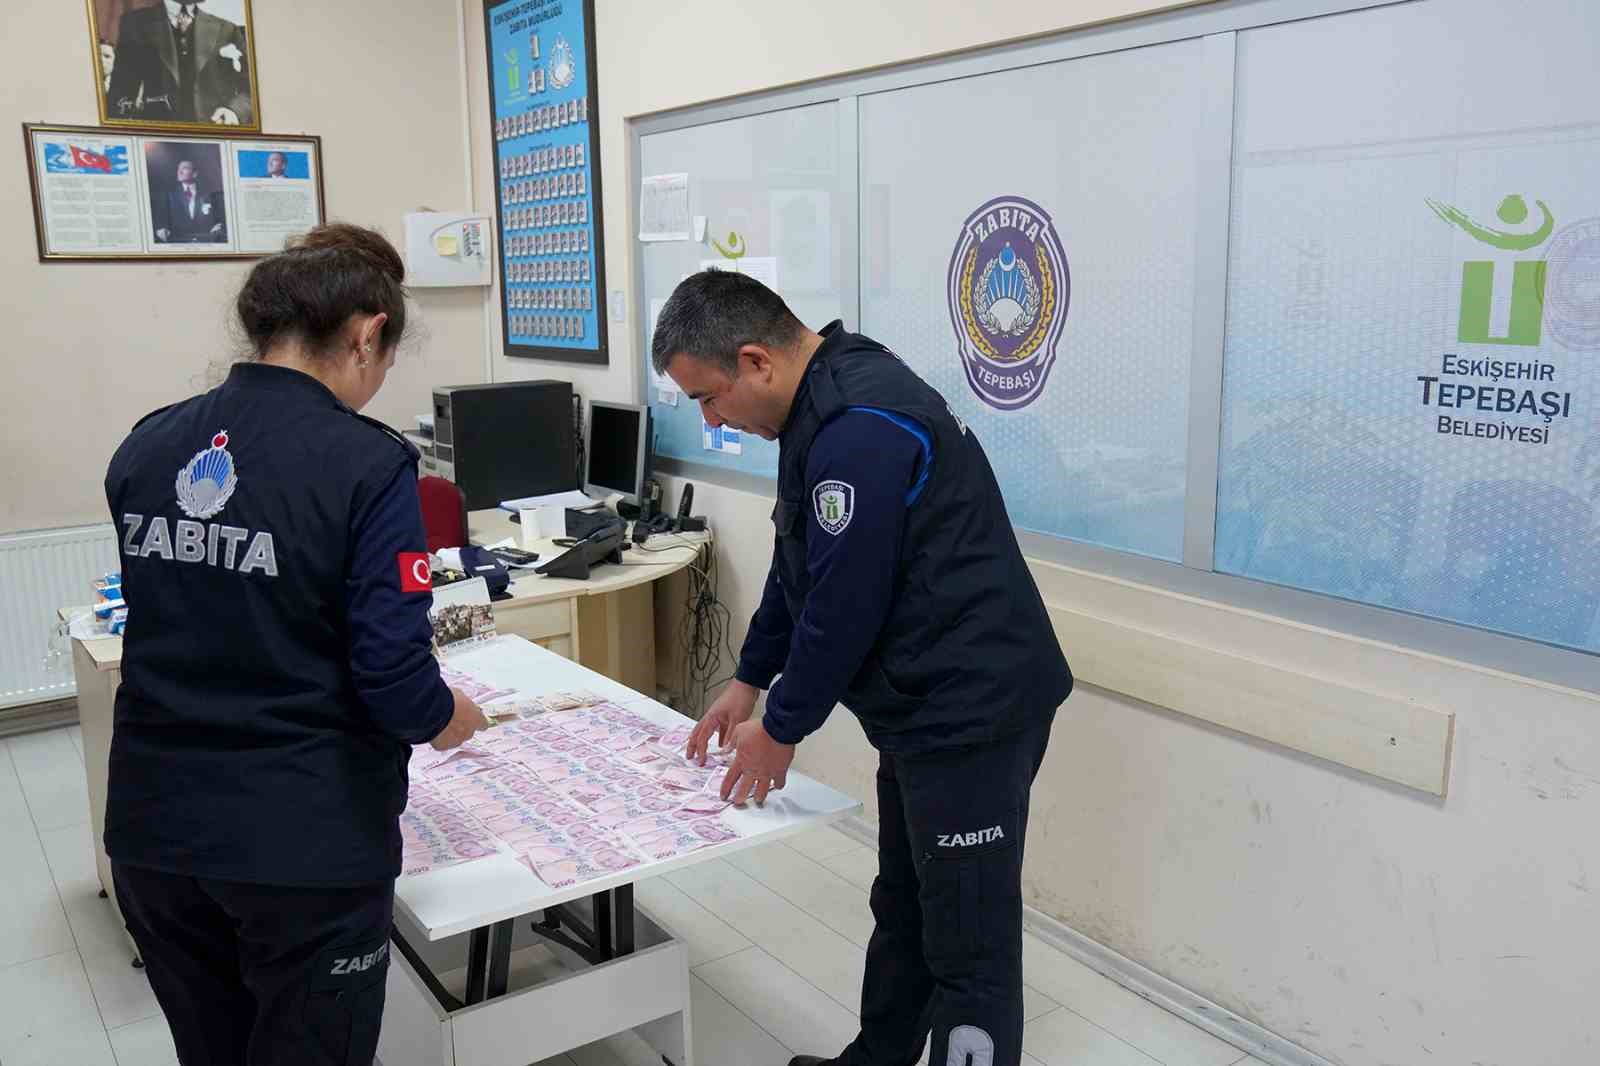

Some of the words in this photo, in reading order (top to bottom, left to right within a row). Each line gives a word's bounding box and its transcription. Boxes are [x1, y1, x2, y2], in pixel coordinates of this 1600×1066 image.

[975, 208, 1040, 243] ZABITA
[978, 364, 1036, 390] TEPEBAŞI
[1442, 354, 1555, 382] ESKİŞEHİR
[1417, 376, 1571, 423] TEPEBAŞI
[1437, 415, 1550, 444] BELEDİYESİ
[122, 512, 279, 577] ZABITA
[937, 825, 1005, 847] ZABITA
[330, 944, 386, 975] ZABIT
